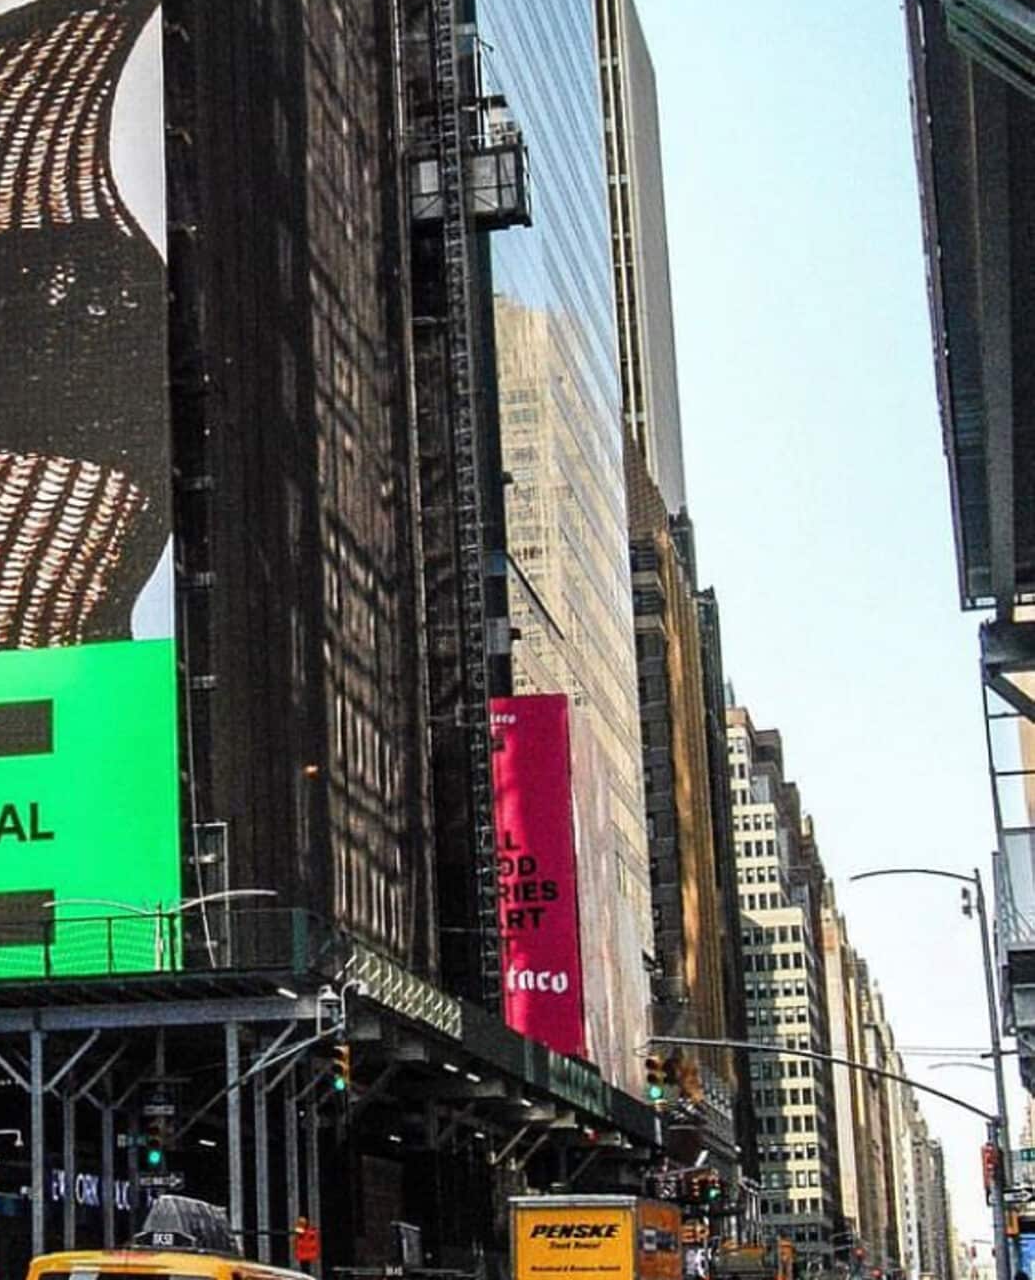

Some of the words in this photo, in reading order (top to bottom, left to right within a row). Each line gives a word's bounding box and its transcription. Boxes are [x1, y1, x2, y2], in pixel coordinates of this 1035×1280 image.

[498, 856, 536, 876] OD
[498, 880, 559, 903] RIES
[506, 907, 546, 929] RT
[530, 1223, 621, 1238] PENSKE
